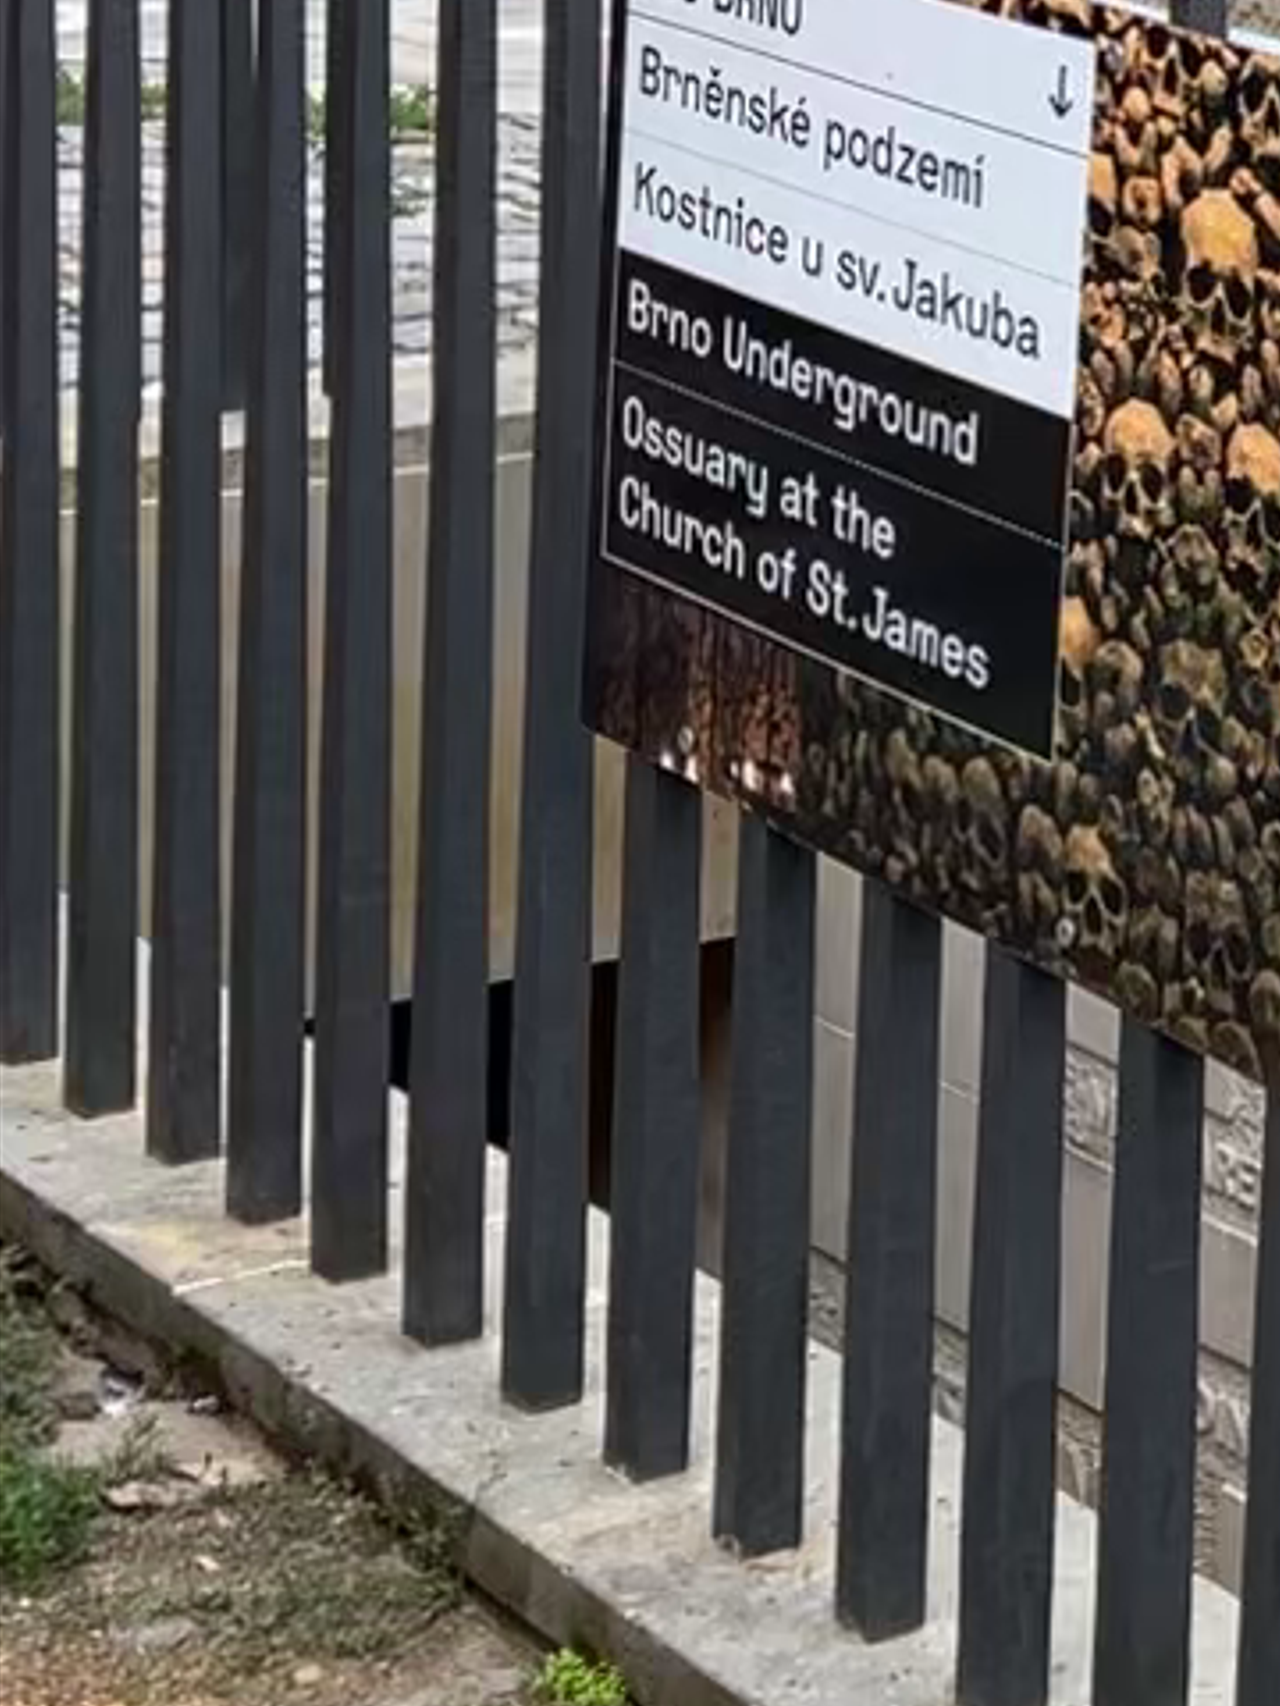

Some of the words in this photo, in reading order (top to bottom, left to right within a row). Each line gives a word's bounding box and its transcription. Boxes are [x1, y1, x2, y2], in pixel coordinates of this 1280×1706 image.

[639, 44, 811, 149] Brněnské
[823, 119, 985, 209] podzemí
[634, 161, 789, 264] Kostnice
[801, 236, 824, 277] u
[628, 277, 714, 358] Brno
[723, 316, 979, 465] Underground
[618, 475, 746, 580] Church
[757, 547, 797, 601] of
[622, 395, 769, 519] Ossuary
[780, 471, 820, 527] at
[831, 486, 897, 559] the
